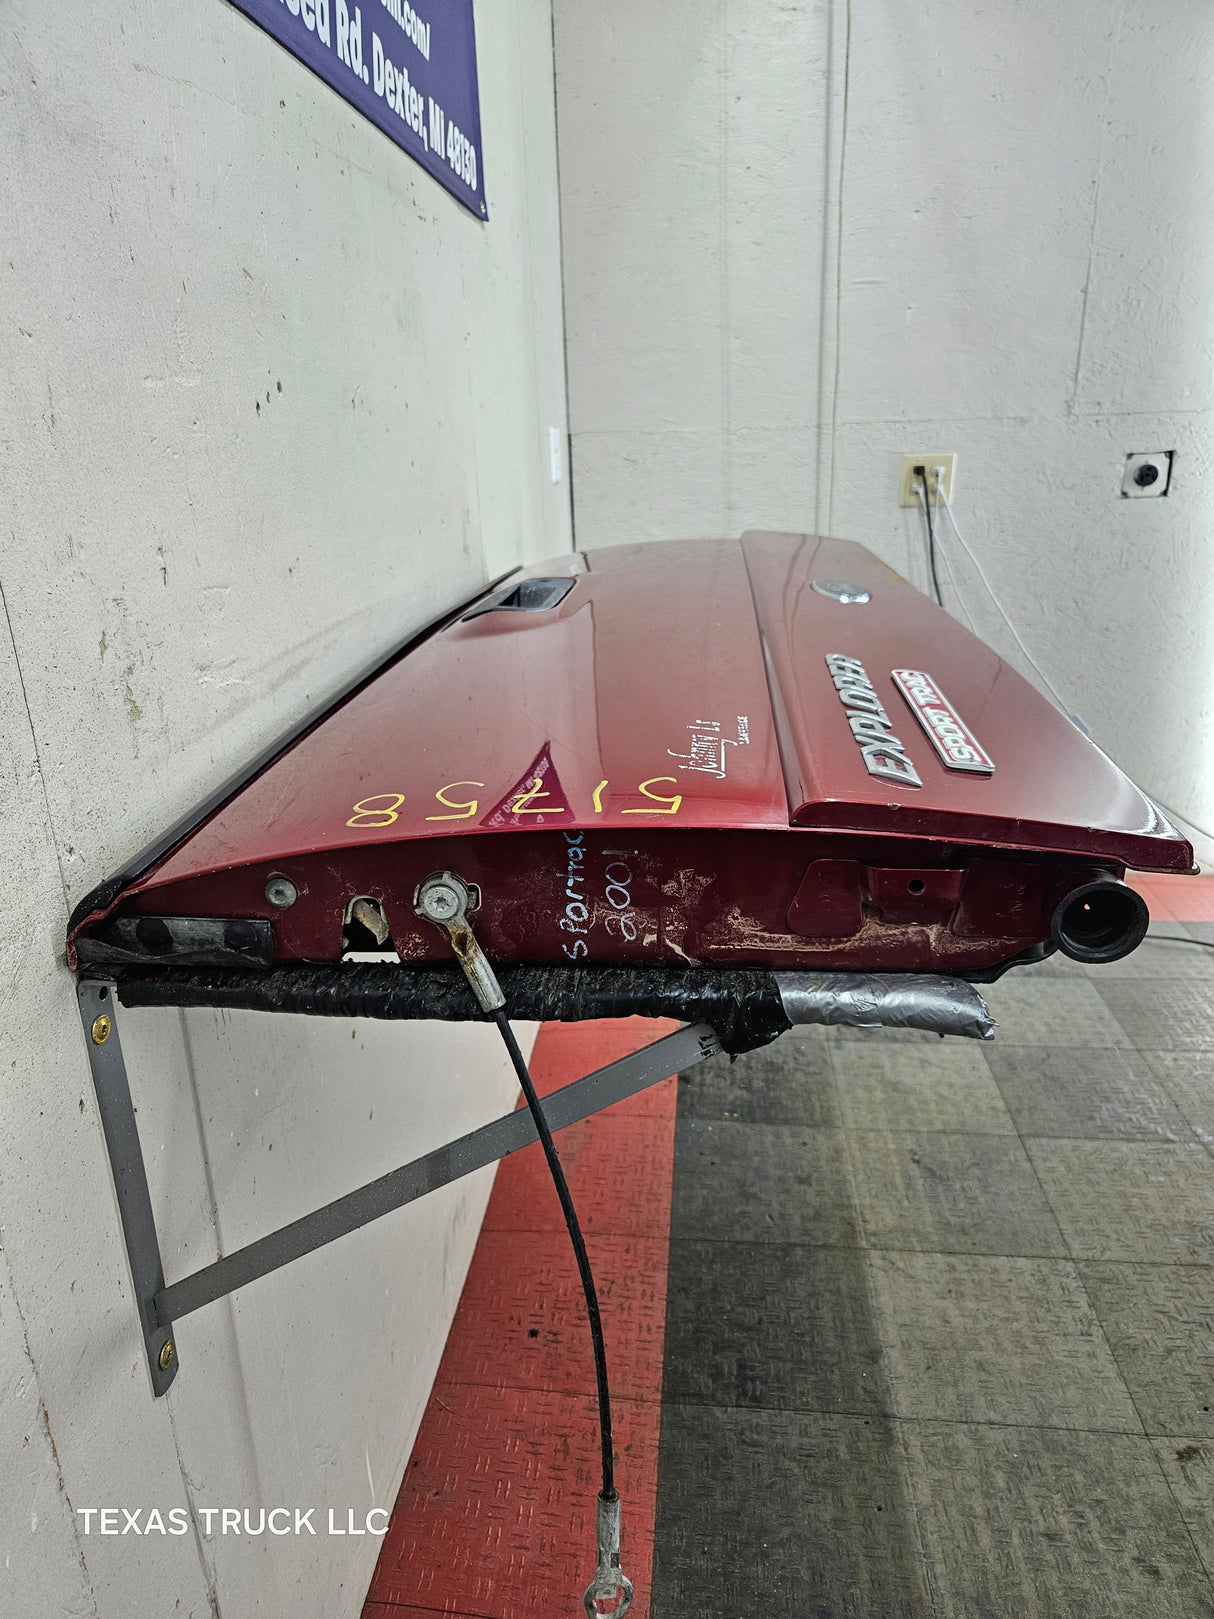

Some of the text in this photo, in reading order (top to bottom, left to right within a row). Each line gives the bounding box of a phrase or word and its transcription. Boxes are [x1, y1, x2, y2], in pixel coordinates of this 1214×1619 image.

[336, 0, 369, 85] Rd.
[372, 31, 428, 152] Dexter,
[428, 96, 446, 160] MI
[446, 120, 477, 191] 48130
[825, 653, 924, 788] EXPLORER
[899, 671, 982, 764] SPORT TRAC
